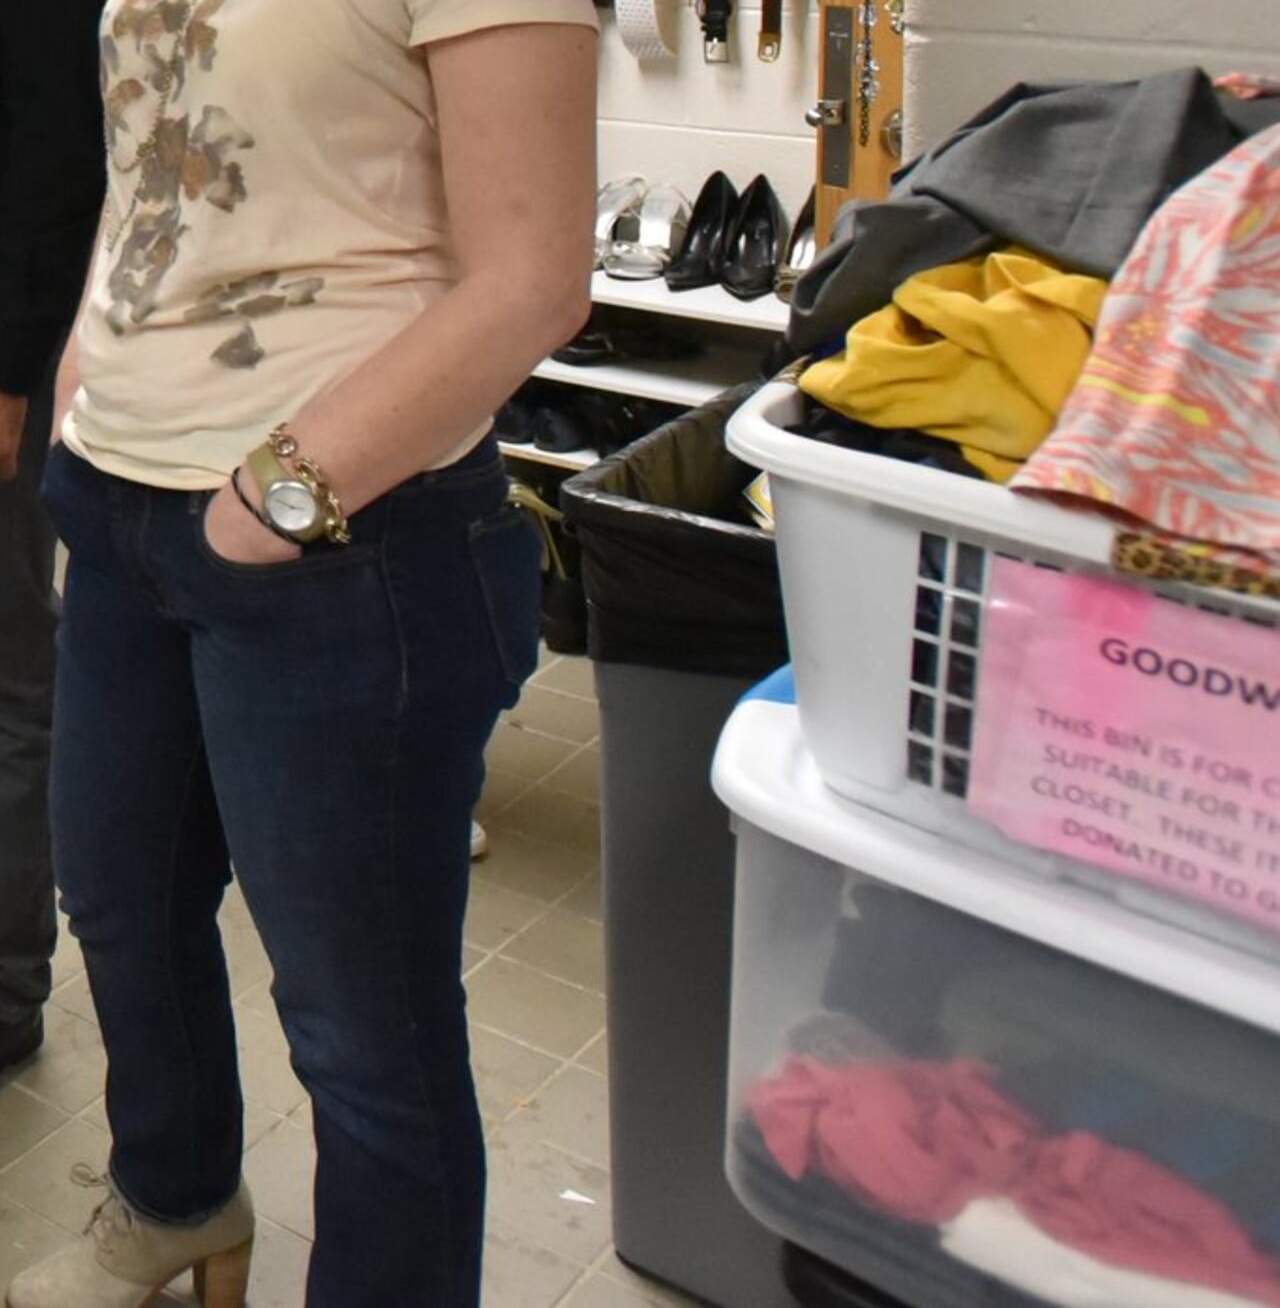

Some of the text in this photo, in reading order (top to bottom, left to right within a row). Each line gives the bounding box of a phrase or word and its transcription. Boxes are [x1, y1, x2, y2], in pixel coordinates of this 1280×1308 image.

[1100, 638, 1280, 712] GOODW
[1035, 706, 1096, 739] THIS
[1104, 725, 1151, 758] BIN
[1159, 745, 1184, 769] IS
[1192, 754, 1252, 789] FOR
[1043, 744, 1170, 802] SUITABLE
[1181, 786, 1240, 823] FOR
[1061, 817, 1198, 882] DONATED
[1208, 869, 1248, 901] TO
[1158, 813, 1244, 865] THESE
